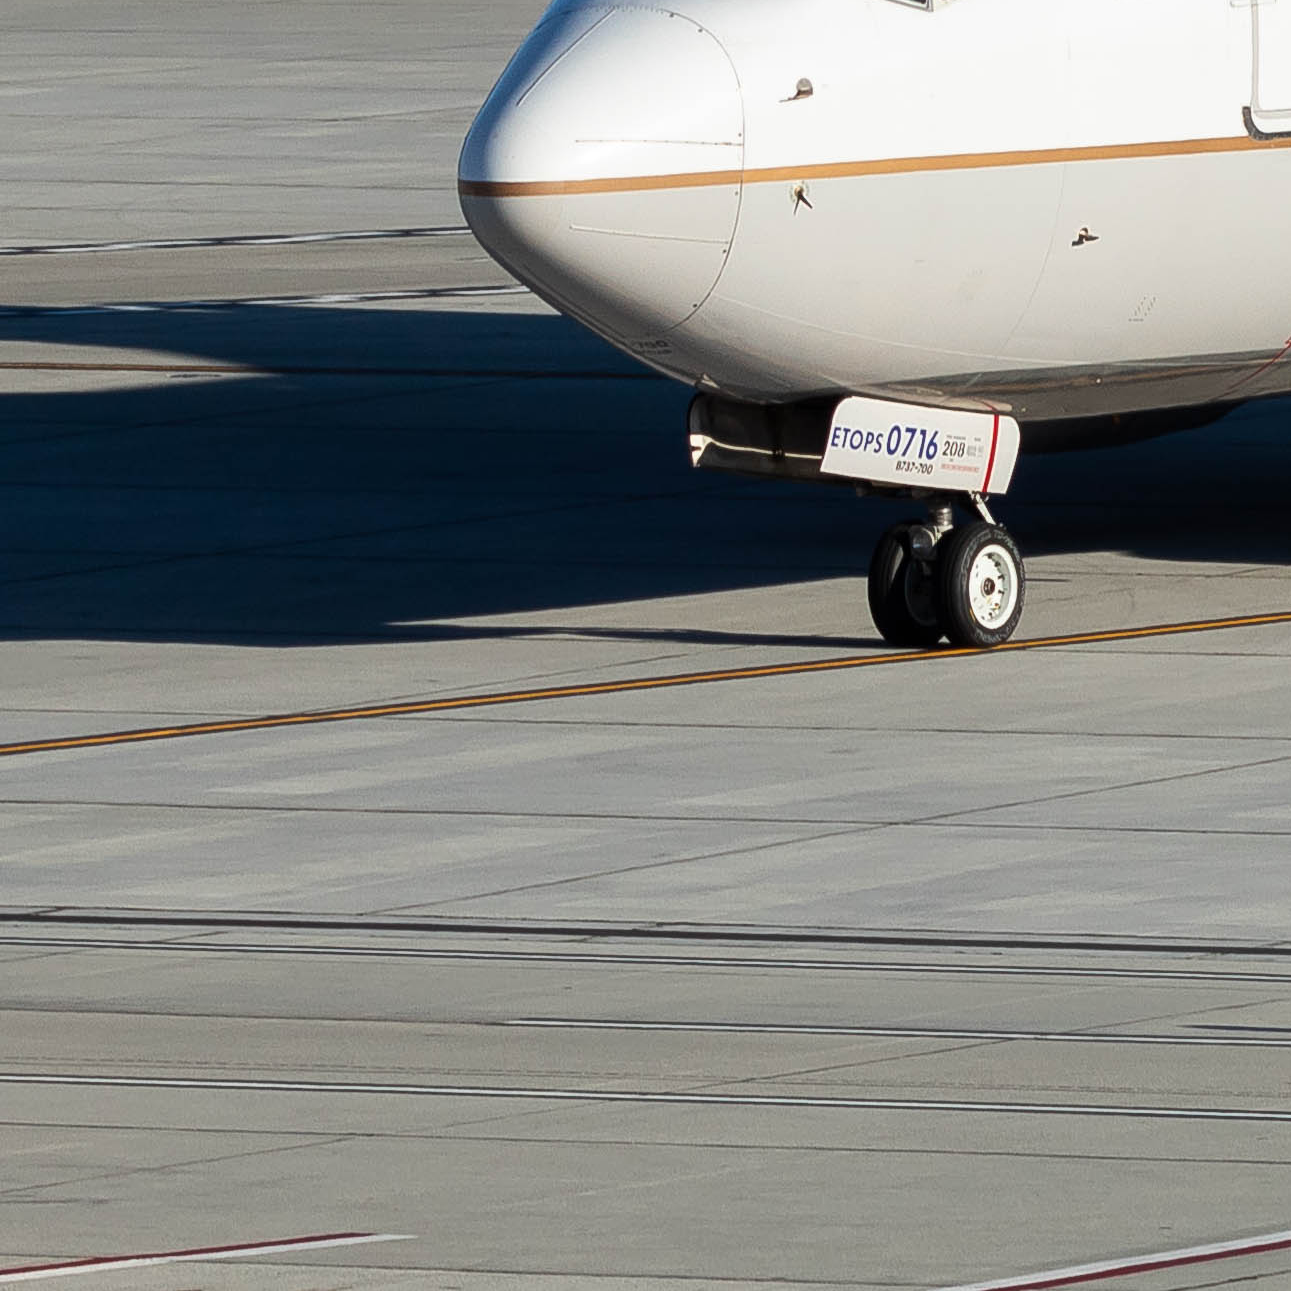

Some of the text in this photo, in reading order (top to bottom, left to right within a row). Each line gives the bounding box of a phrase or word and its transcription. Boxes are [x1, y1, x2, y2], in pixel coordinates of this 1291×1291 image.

[831, 426, 884, 454] ETOPS
[886, 424, 940, 461] 0716
[942, 440, 966, 458] 208
